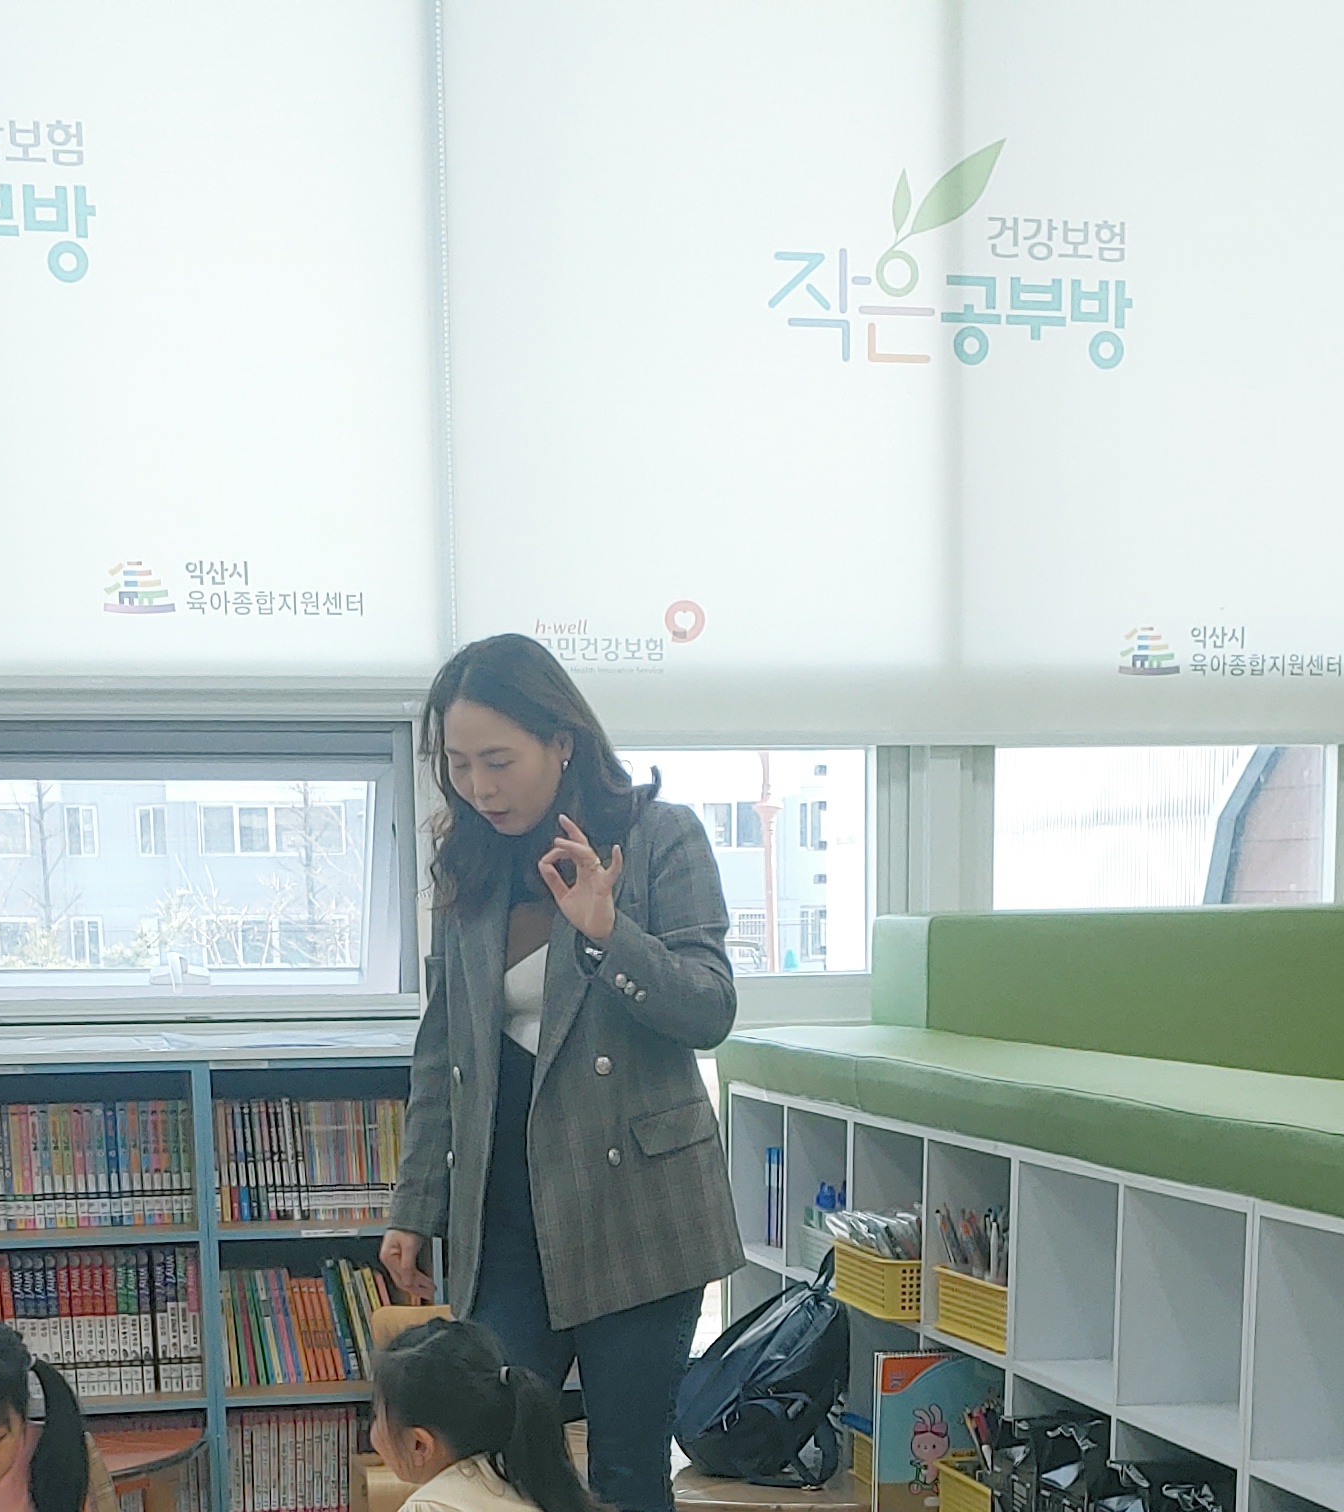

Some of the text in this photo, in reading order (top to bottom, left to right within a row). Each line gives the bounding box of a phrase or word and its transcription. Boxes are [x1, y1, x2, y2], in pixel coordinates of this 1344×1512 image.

[988, 216, 1127, 262] 건강보험
[185, 560, 249, 586] 익산시
[186, 590, 364, 616] 육아종합지원센터
[1190, 626, 1246, 649] 익산시
[1190, 653, 1343, 677] 육아종합지원센터
